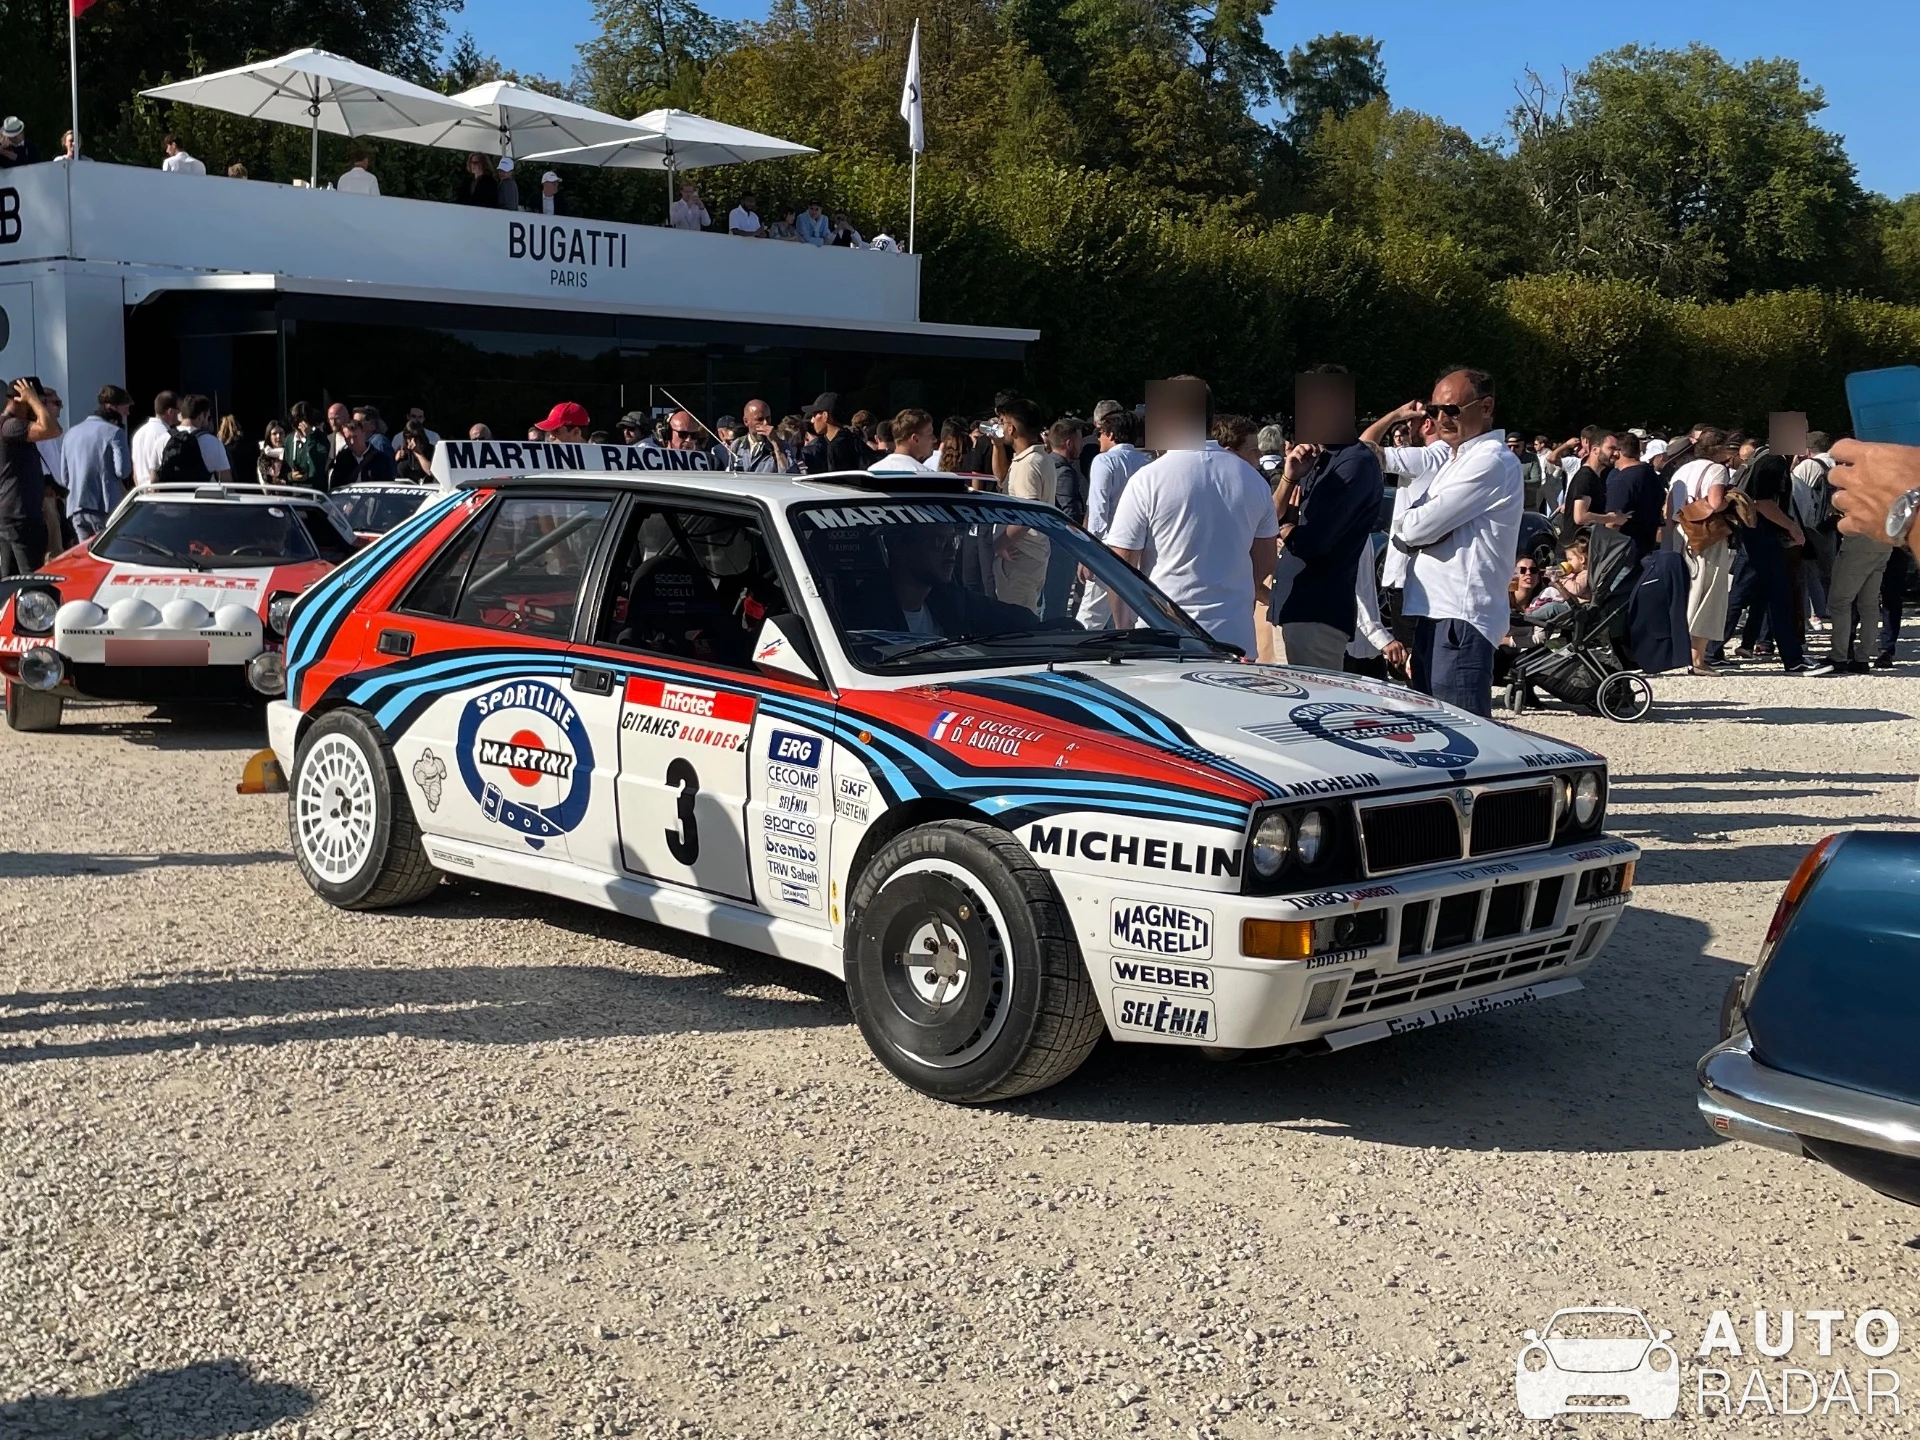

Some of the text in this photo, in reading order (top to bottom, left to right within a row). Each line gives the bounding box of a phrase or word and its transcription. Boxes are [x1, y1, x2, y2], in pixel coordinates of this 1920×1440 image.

[509, 221, 627, 268] BUGATTI
[550, 269, 588, 288] PARIS
[445, 442, 708, 471] MARTINI RACING
[805, 504, 1067, 531] MARTINI RACING
[655, 588, 695, 597] OCCELLI
[0, 636, 55, 652] LANCIA
[476, 684, 575, 731] SPORTLINE
[660, 690, 714, 717] infotec
[621, 711, 740, 750] GITANES BLONDES
[950, 727, 1021, 757] D. AURIOL
[960, 716, 1045, 743] B. OCCELLI
[482, 742, 571, 776] MARTINI
[777, 737, 812, 761] ERG
[1519, 751, 1586, 768] MICHELIN
[768, 765, 819, 790] CECOMP
[840, 779, 867, 798] SKF
[1286, 773, 1381, 797] MICHELIN
[664, 757, 701, 867] 3
[764, 813, 815, 835] sparco
[835, 798, 868, 823] BILSTEIN
[765, 836, 816, 863] brembo
[1029, 824, 1243, 878] MICHELIN
[767, 859, 819, 885] TRW Sabelt
[856, 835, 947, 909] MICHELIN
[1452, 870, 1475, 880] TO
[1282, 885, 1399, 910] TURBO GARRETT
[1114, 904, 1209, 947] MAGNETI
[1114, 908, 1209, 953] MARELLI
[1114, 961, 1209, 990] WEBER
